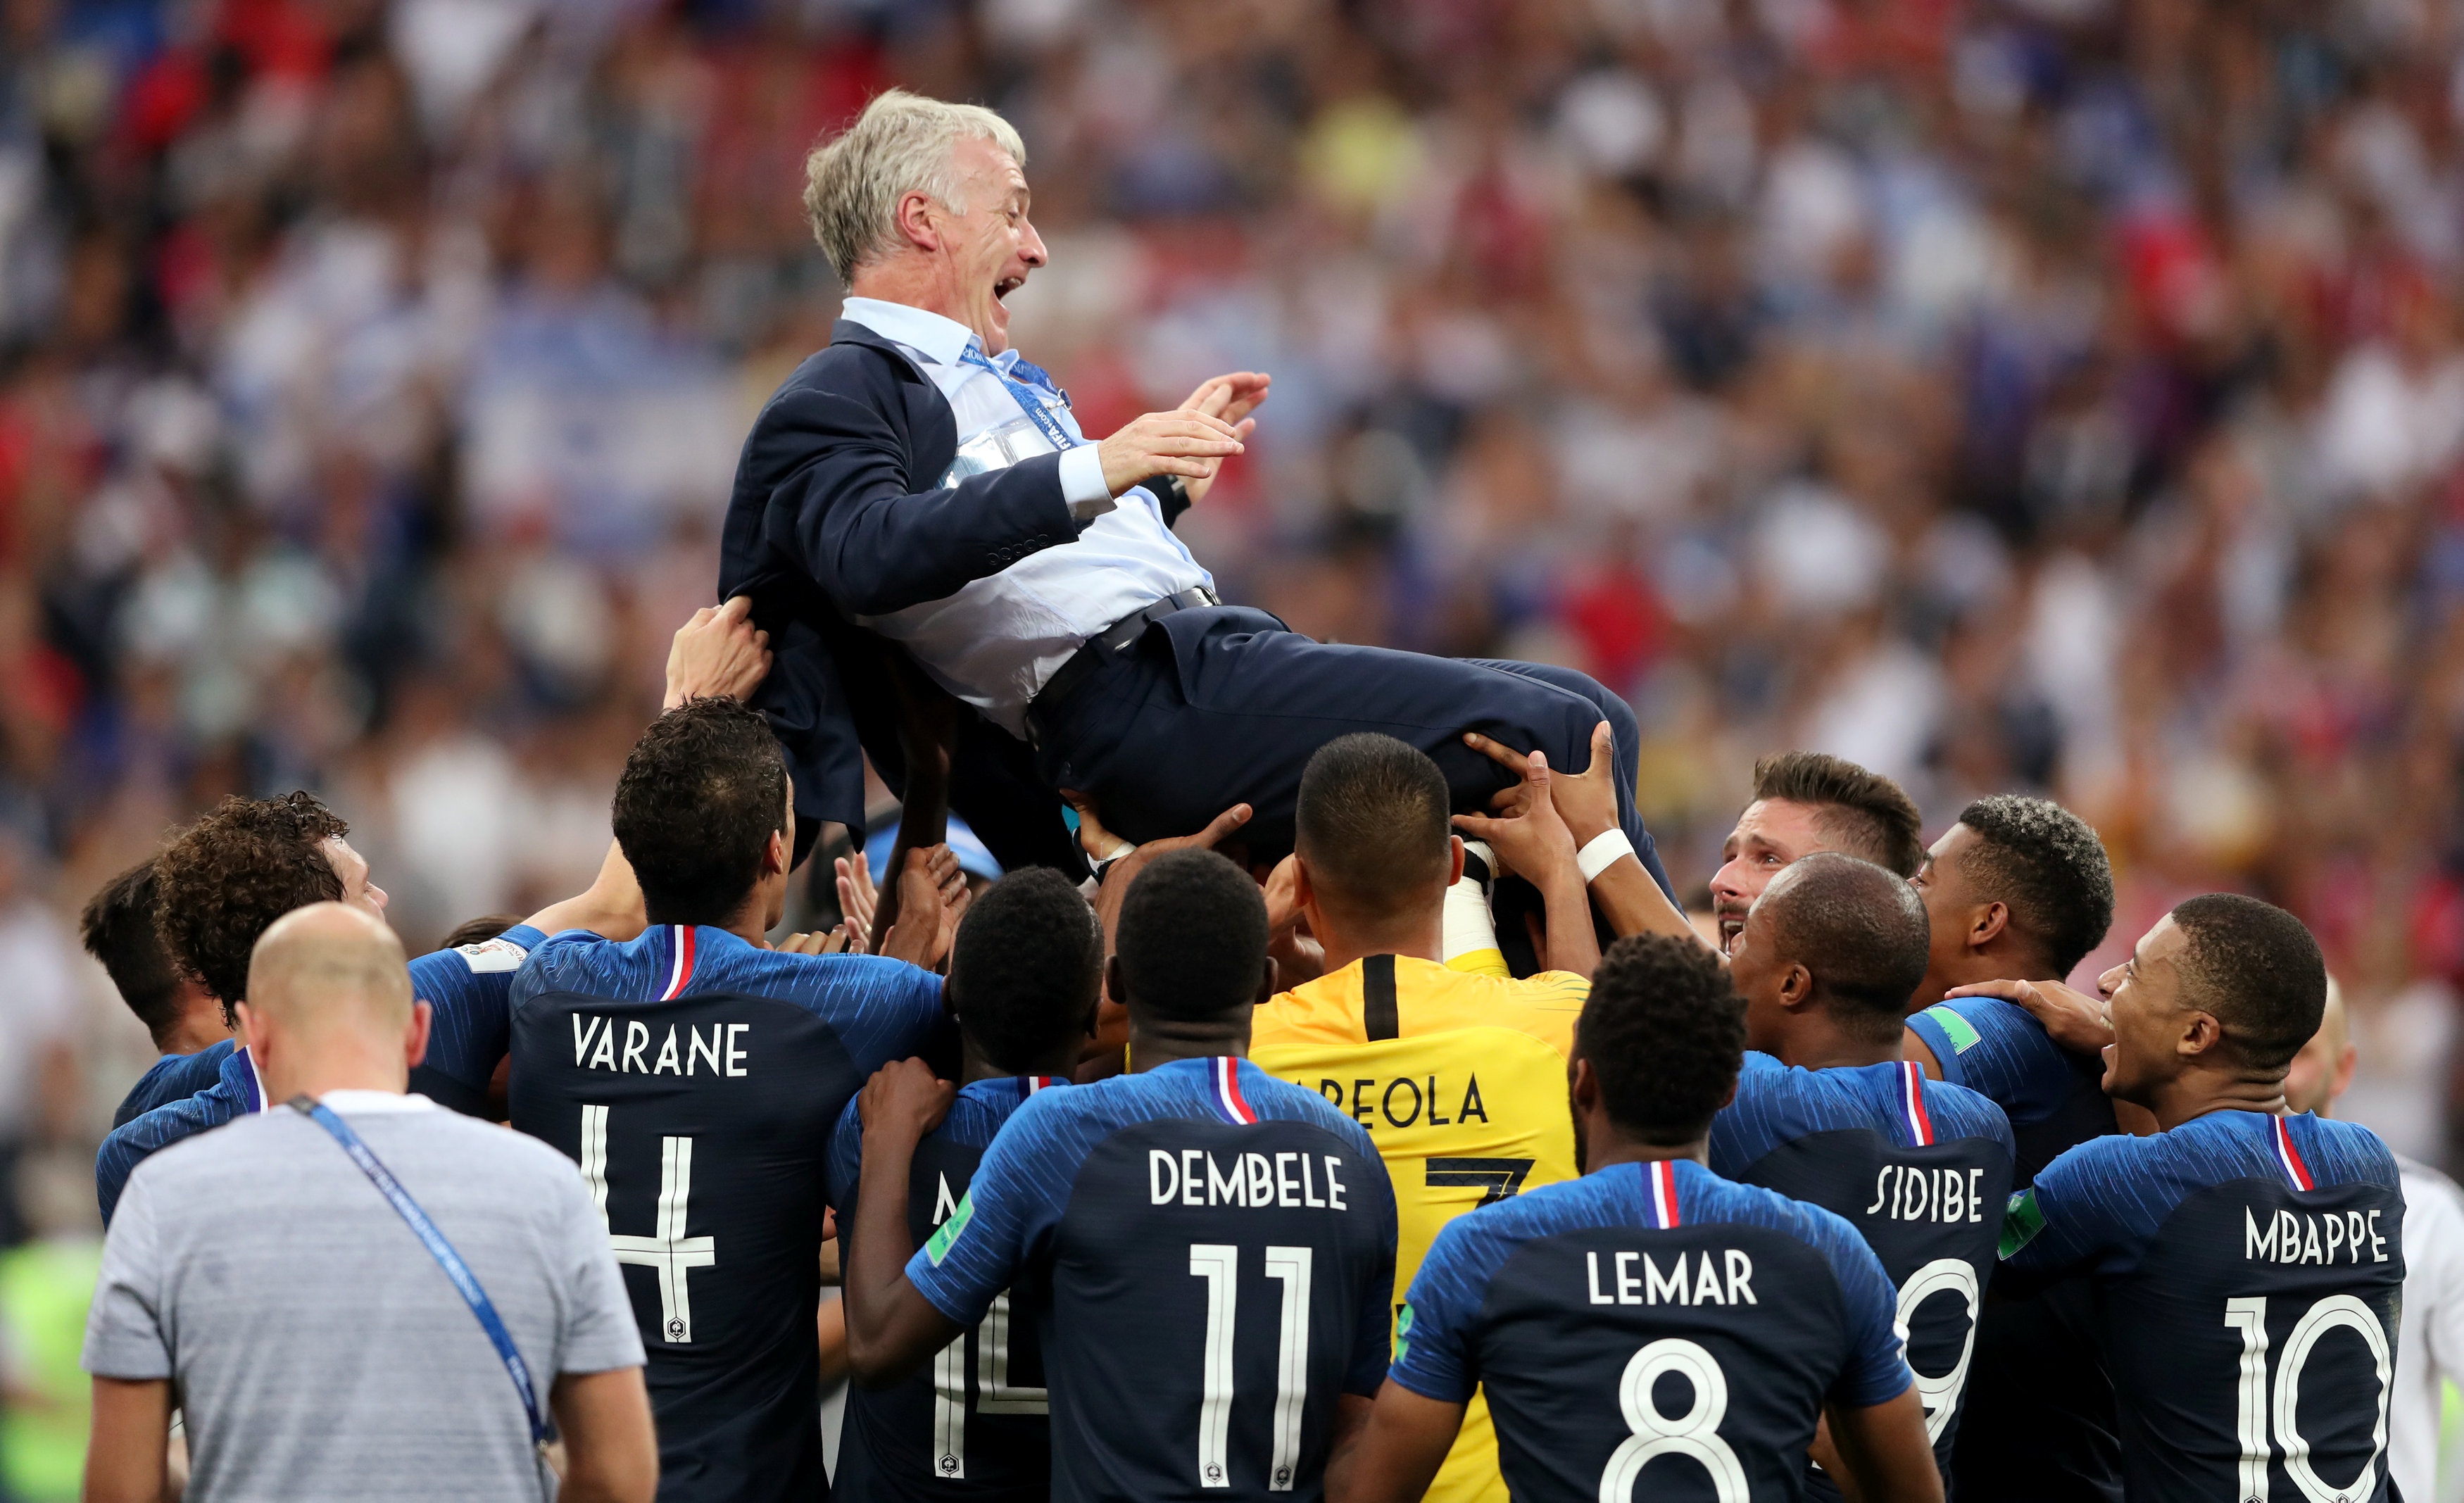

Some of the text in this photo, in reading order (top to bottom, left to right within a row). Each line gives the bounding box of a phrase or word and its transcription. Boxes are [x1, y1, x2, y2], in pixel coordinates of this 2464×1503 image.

[572, 1012, 750, 1077] VARANE
[1295, 1071, 1489, 1130] REOLA
[1149, 1149, 1347, 1211] DEMBELE
[1866, 1164, 1983, 1224] SIDIBE
[580, 1104, 715, 1343] 4
[2245, 1205, 2389, 1266] MBAPPE
[1586, 1249, 1759, 1306] LEMAR
[1189, 1243, 1313, 1491] 11
[2224, 1293, 2392, 1503] 10
[1598, 1338, 1751, 1503] 8
